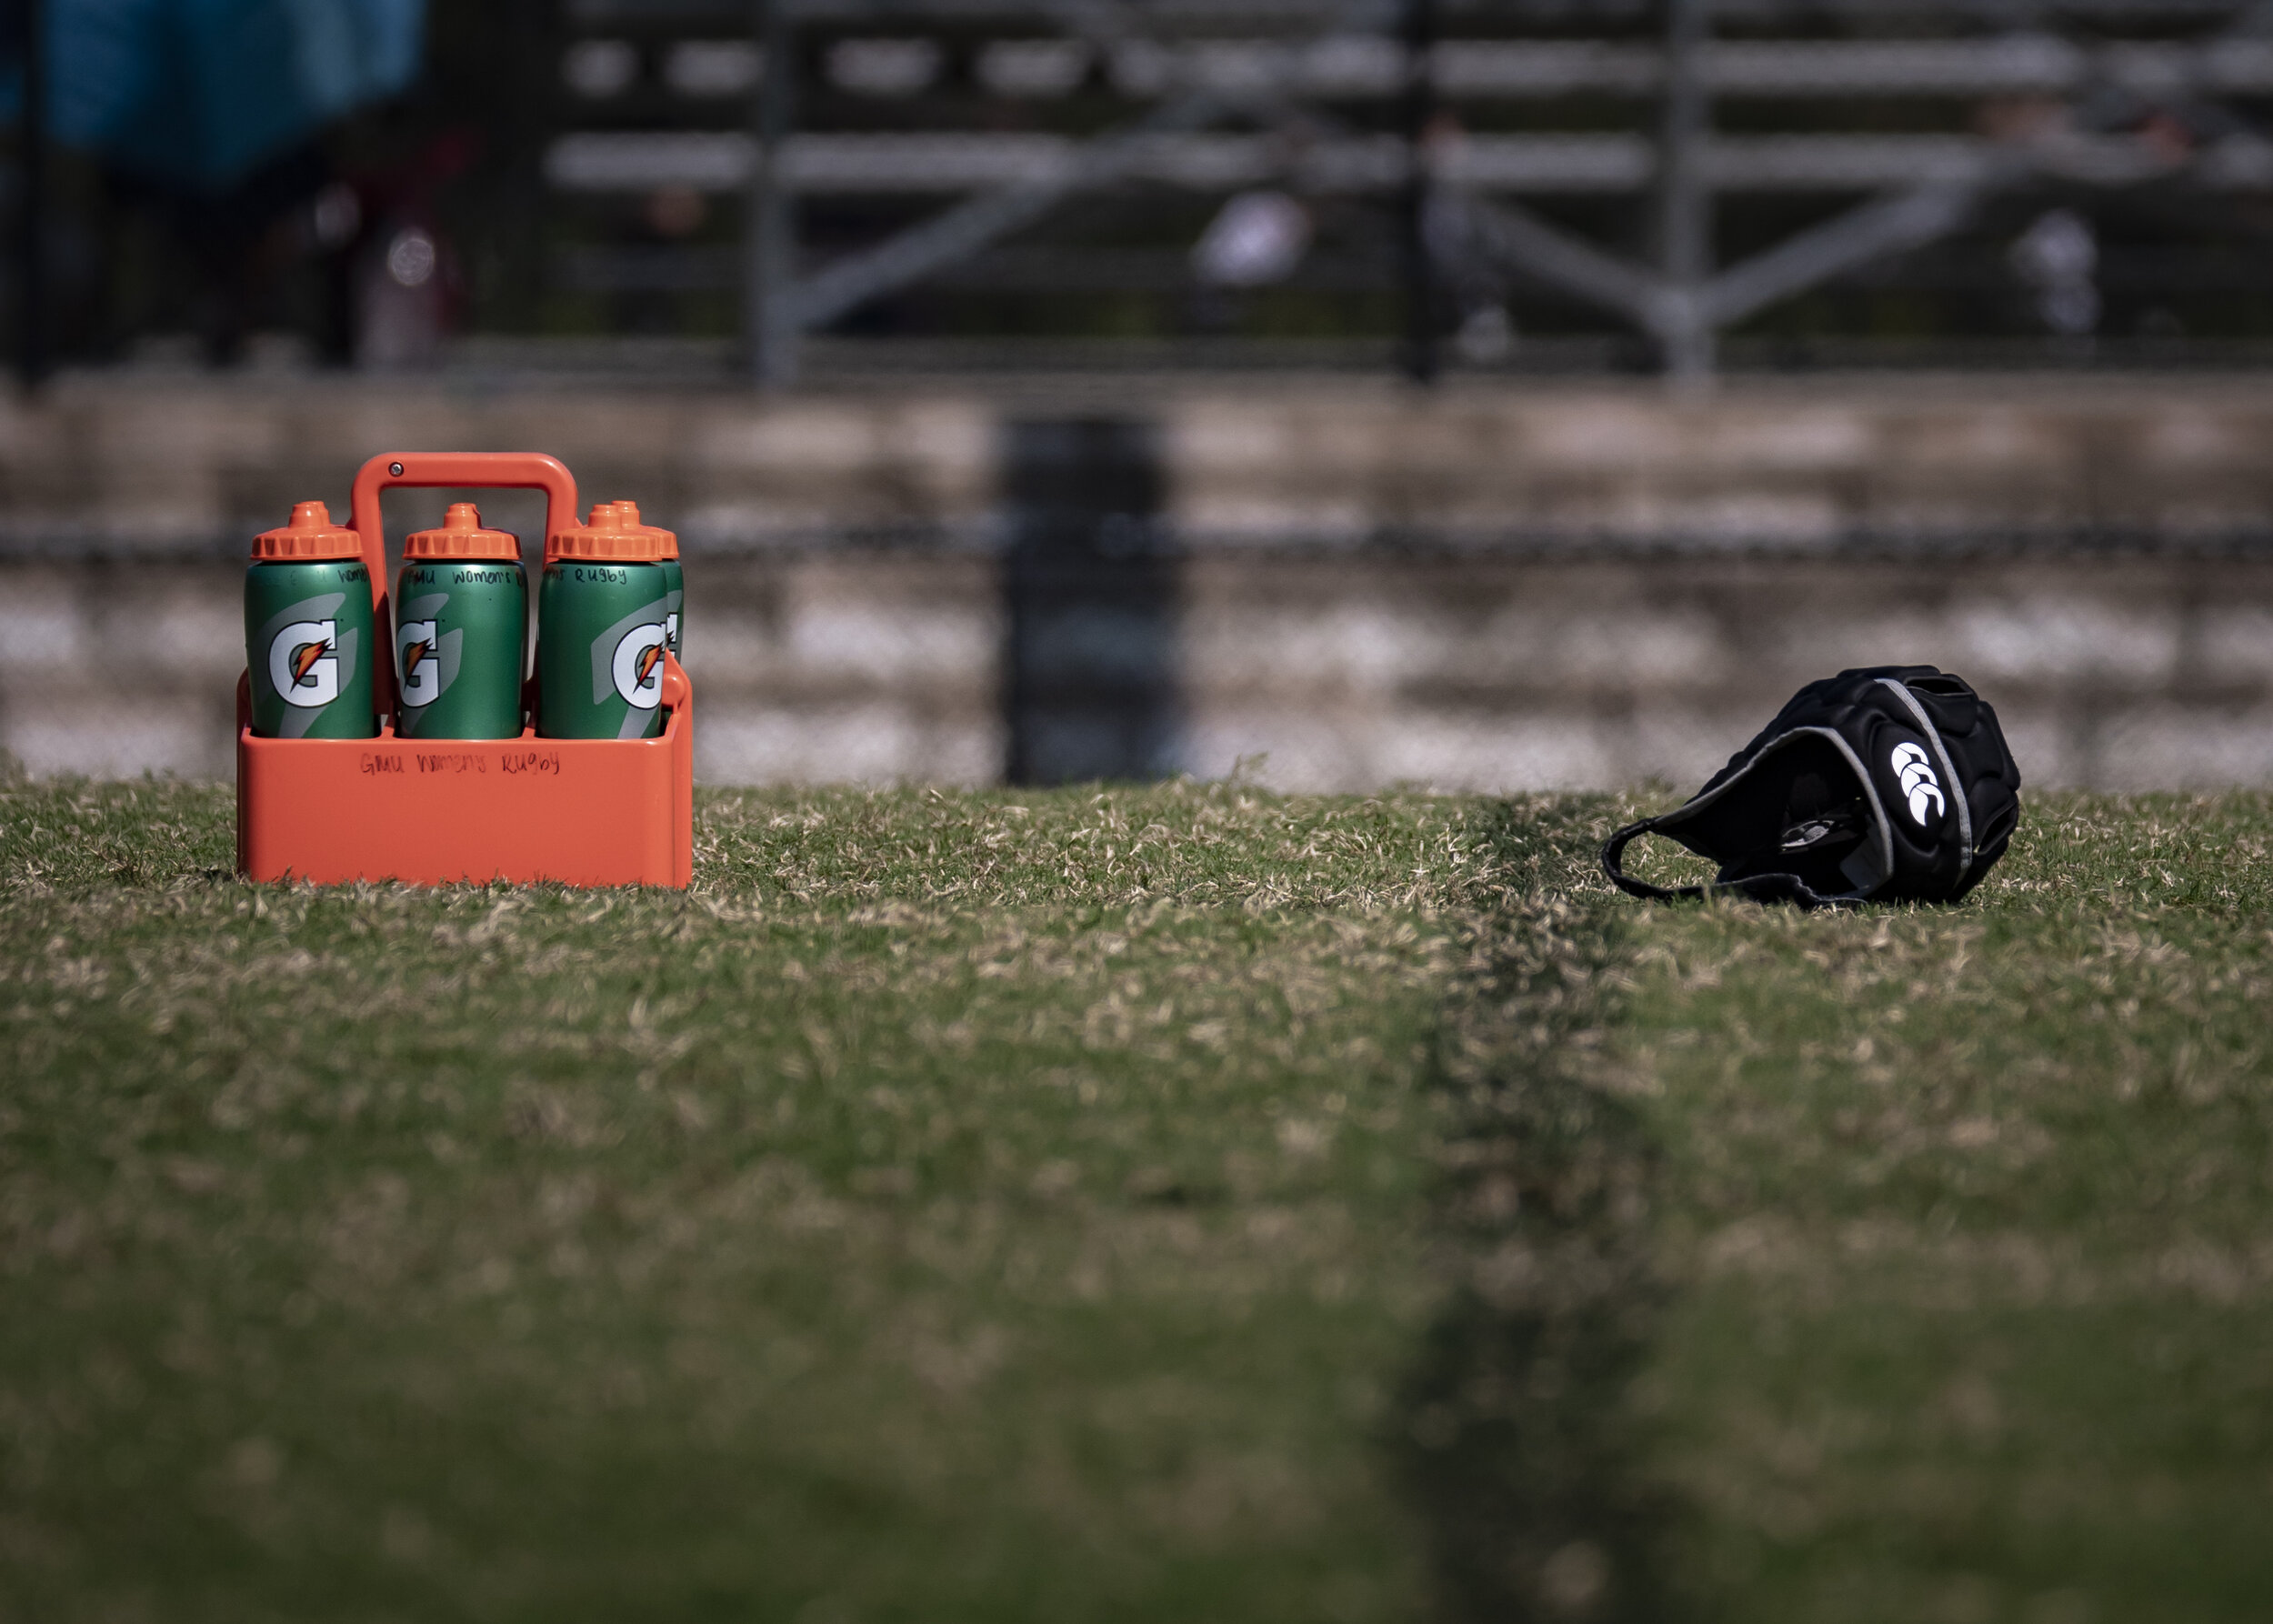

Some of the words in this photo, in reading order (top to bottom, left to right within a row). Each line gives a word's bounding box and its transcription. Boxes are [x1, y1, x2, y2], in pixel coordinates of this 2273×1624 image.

[267, 619, 340, 708] G
[396, 619, 441, 708] G
[611, 622, 666, 710] G
[360, 752, 405, 776] GMU
